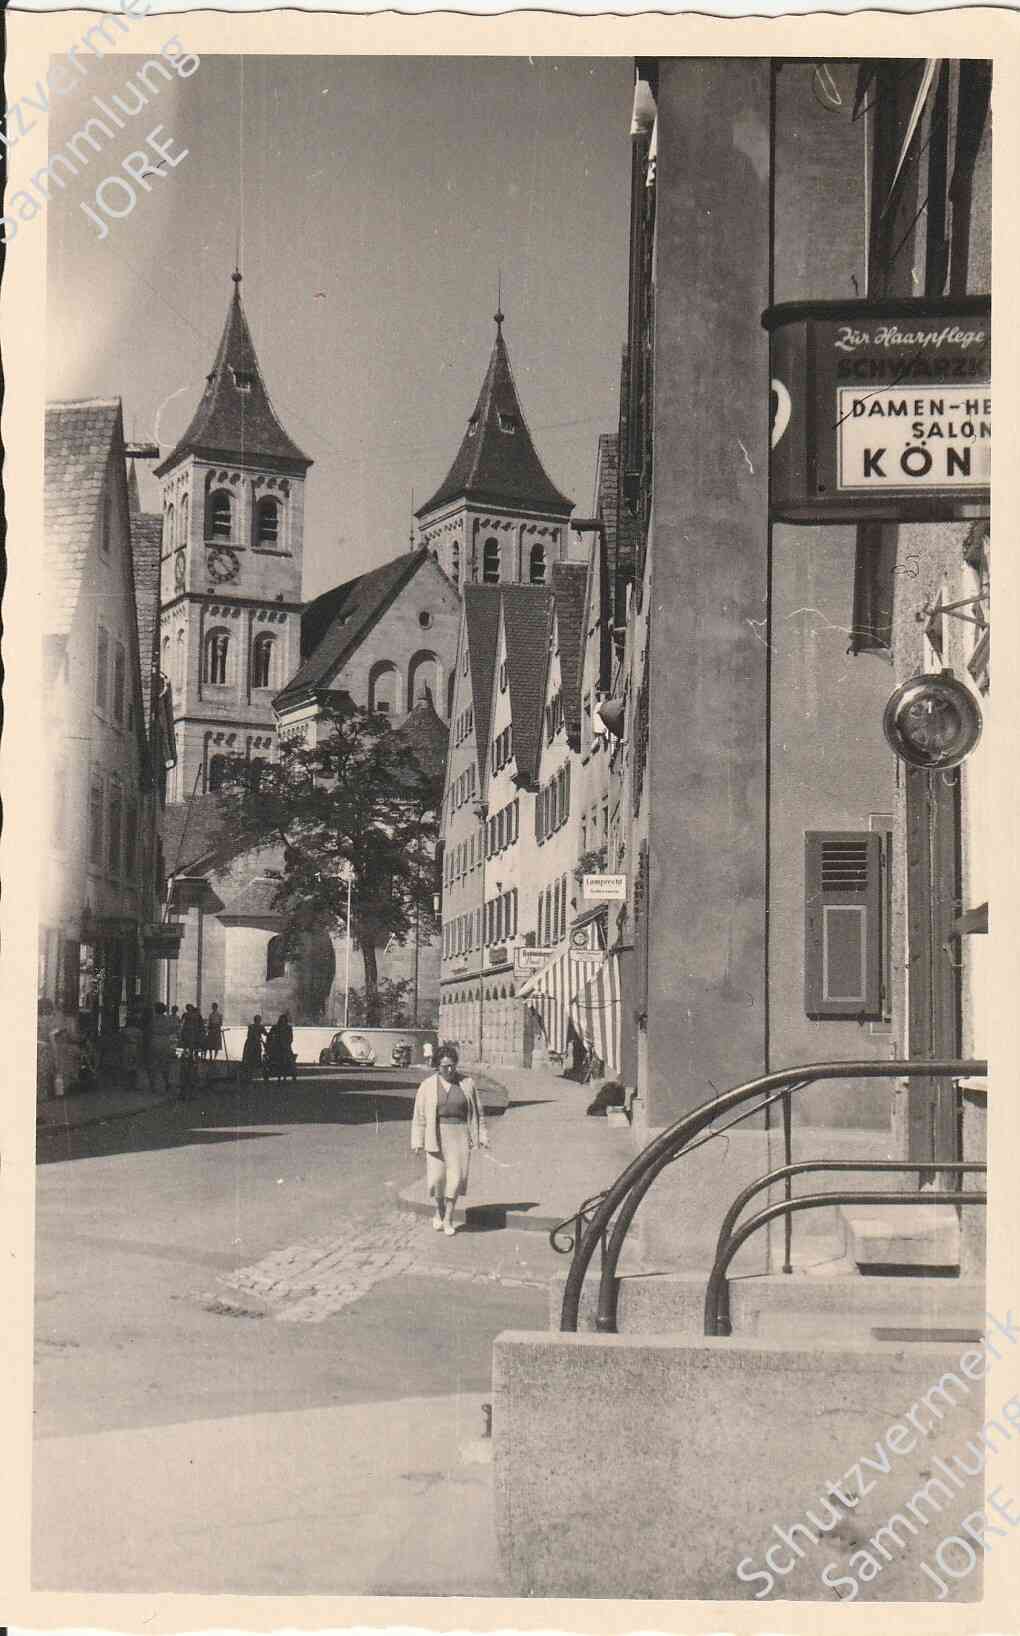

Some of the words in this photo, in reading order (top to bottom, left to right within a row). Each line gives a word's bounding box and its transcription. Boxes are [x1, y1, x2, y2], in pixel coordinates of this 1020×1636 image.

[874, 326, 985, 348] Haarpflege
[912, 422, 991, 439] SALON
[863, 441, 971, 477] KÖN
